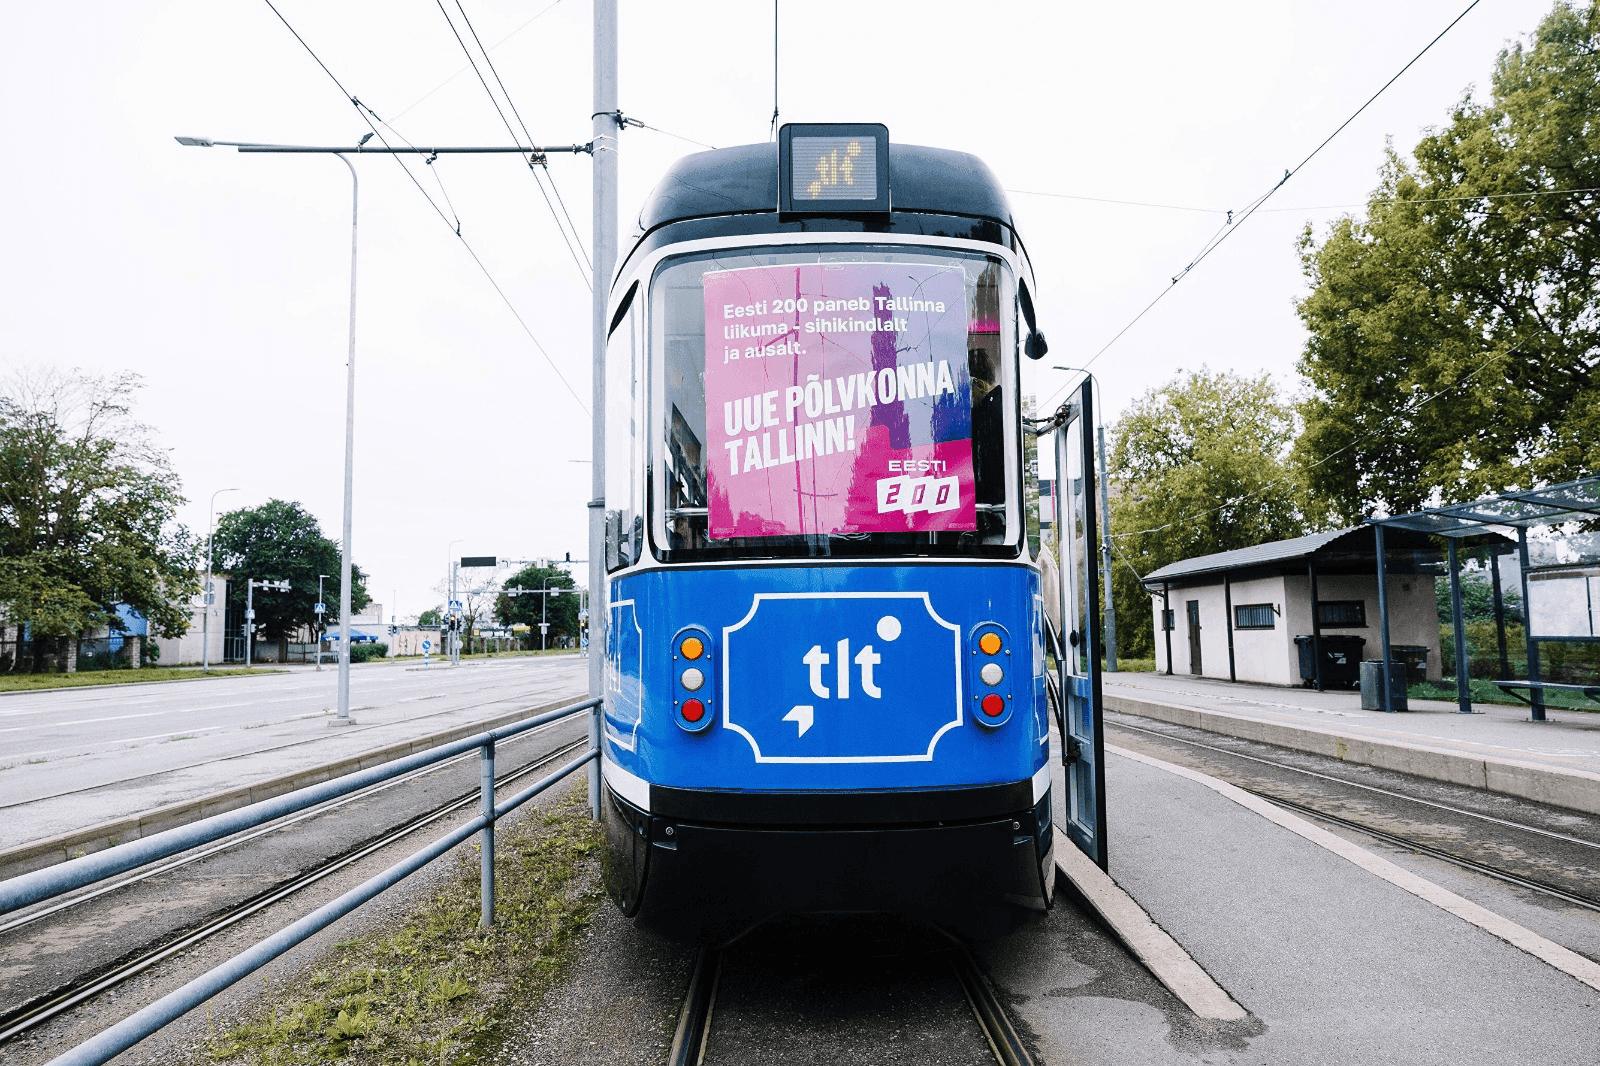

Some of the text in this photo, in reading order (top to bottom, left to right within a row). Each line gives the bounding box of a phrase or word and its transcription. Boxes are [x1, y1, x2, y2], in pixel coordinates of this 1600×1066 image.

[723, 296, 946, 319] Eesti 200 paneb Tallinna
[723, 321, 788, 339] liikuma
[804, 317, 908, 333] sihikindlalt
[723, 341, 807, 364] ja ausalt.
[724, 360, 955, 436] UUE PÕLVKONNA
[724, 415, 855, 476] TALLINN!
[888, 460, 947, 472] EESTI
[884, 481, 952, 507] 200
[802, 638, 882, 699] tlt
